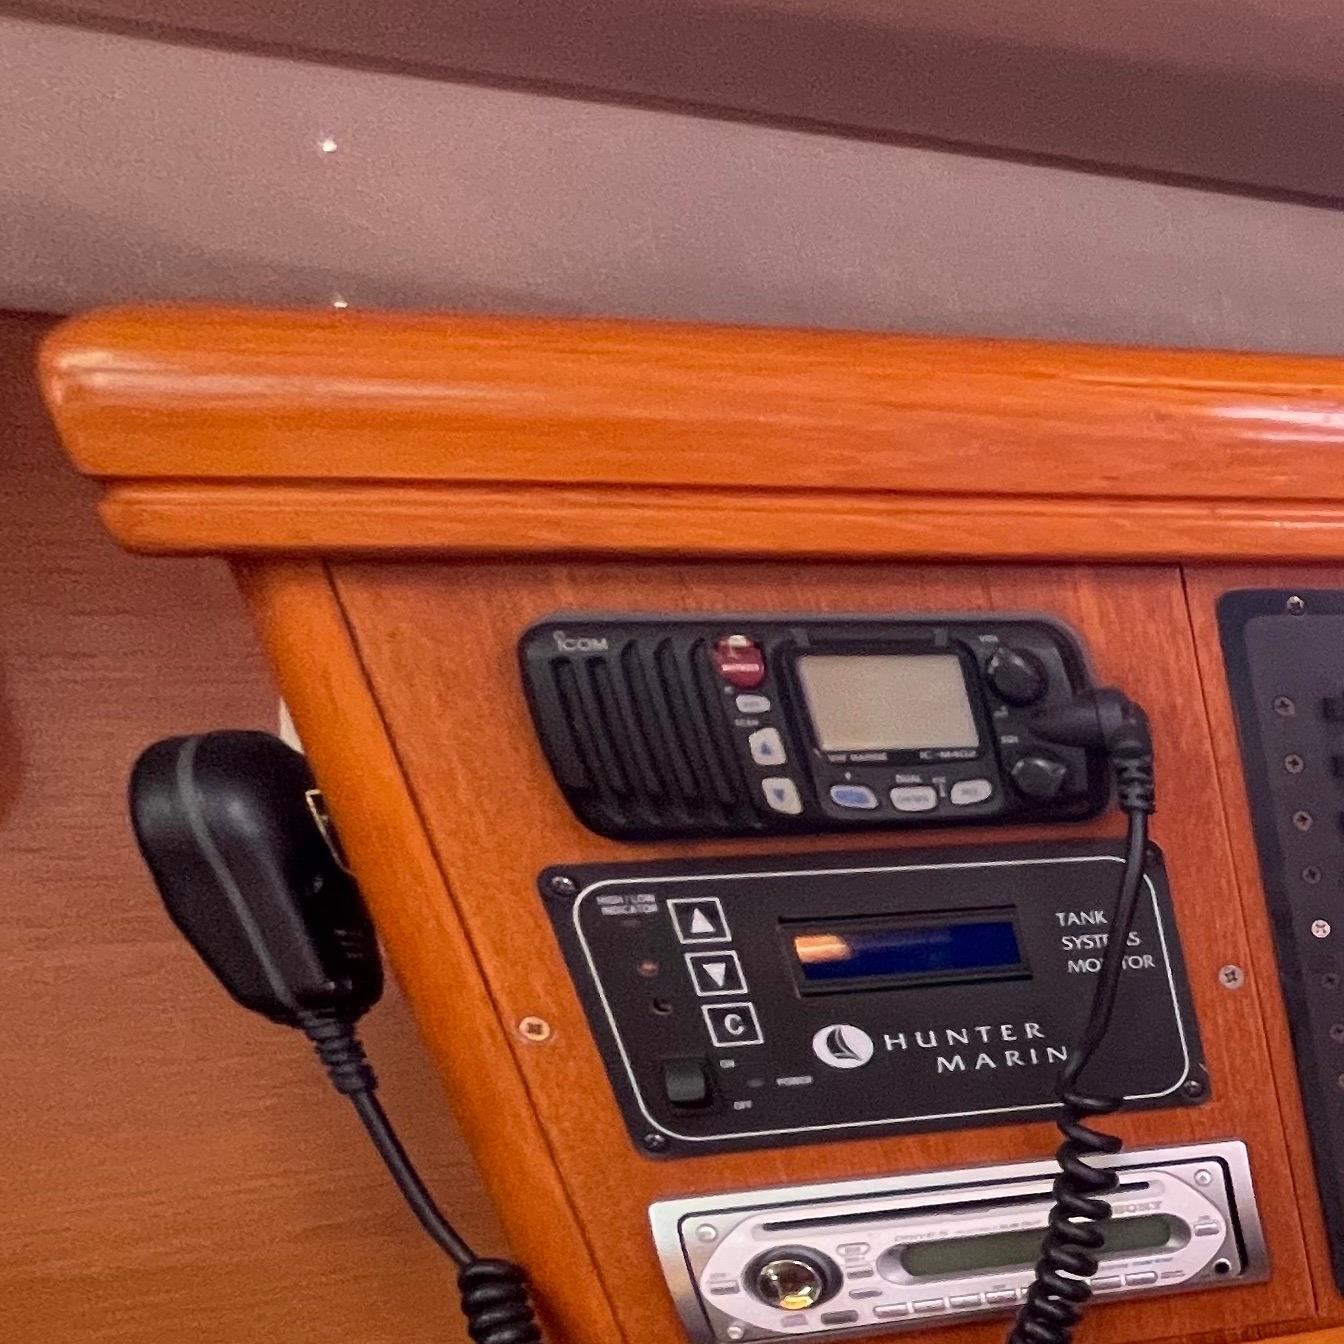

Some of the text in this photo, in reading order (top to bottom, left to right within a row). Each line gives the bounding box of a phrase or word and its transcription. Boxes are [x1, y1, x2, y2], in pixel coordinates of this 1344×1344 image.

[1055, 911, 1107, 926] TANK
[725, 1013, 745, 1035] C
[884, 1022, 1045, 1051] HUNTER
[937, 1045, 1069, 1073] MARIN
